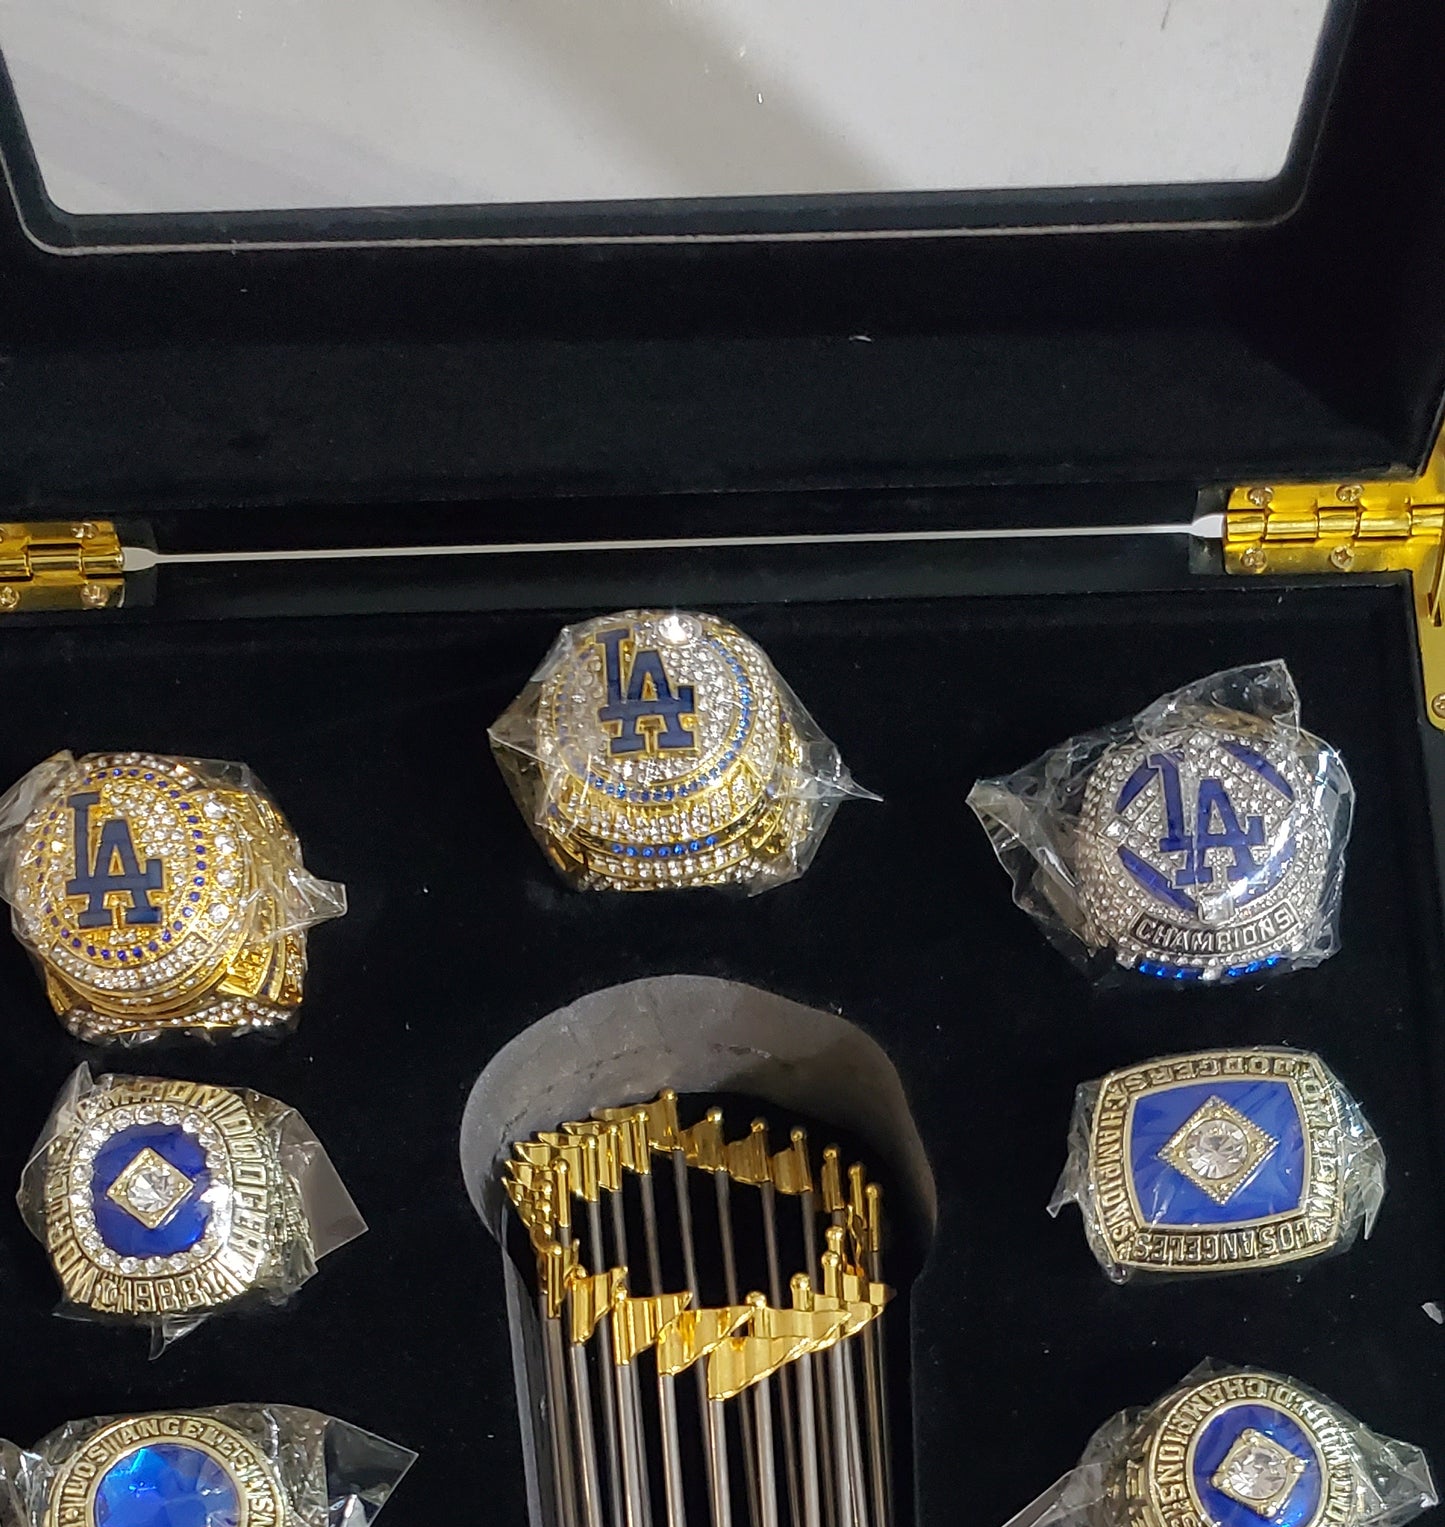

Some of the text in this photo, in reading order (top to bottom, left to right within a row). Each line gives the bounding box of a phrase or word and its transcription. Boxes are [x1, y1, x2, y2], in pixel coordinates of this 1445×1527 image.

[594, 627, 699, 753] LA
[66, 791, 163, 930] LA
[1146, 752, 1268, 889] LA
[1136, 909, 1294, 949] CHAMPIONS
[1124, 1056, 1295, 1092] DODGERS
[1096, 1097, 1134, 1240] CHAMPIONS
[122, 1276, 201, 1314] 1988
[65, 1417, 257, 1496] LOS ANGELES
[1157, 1377, 1267, 1501] CHAMPIONS
